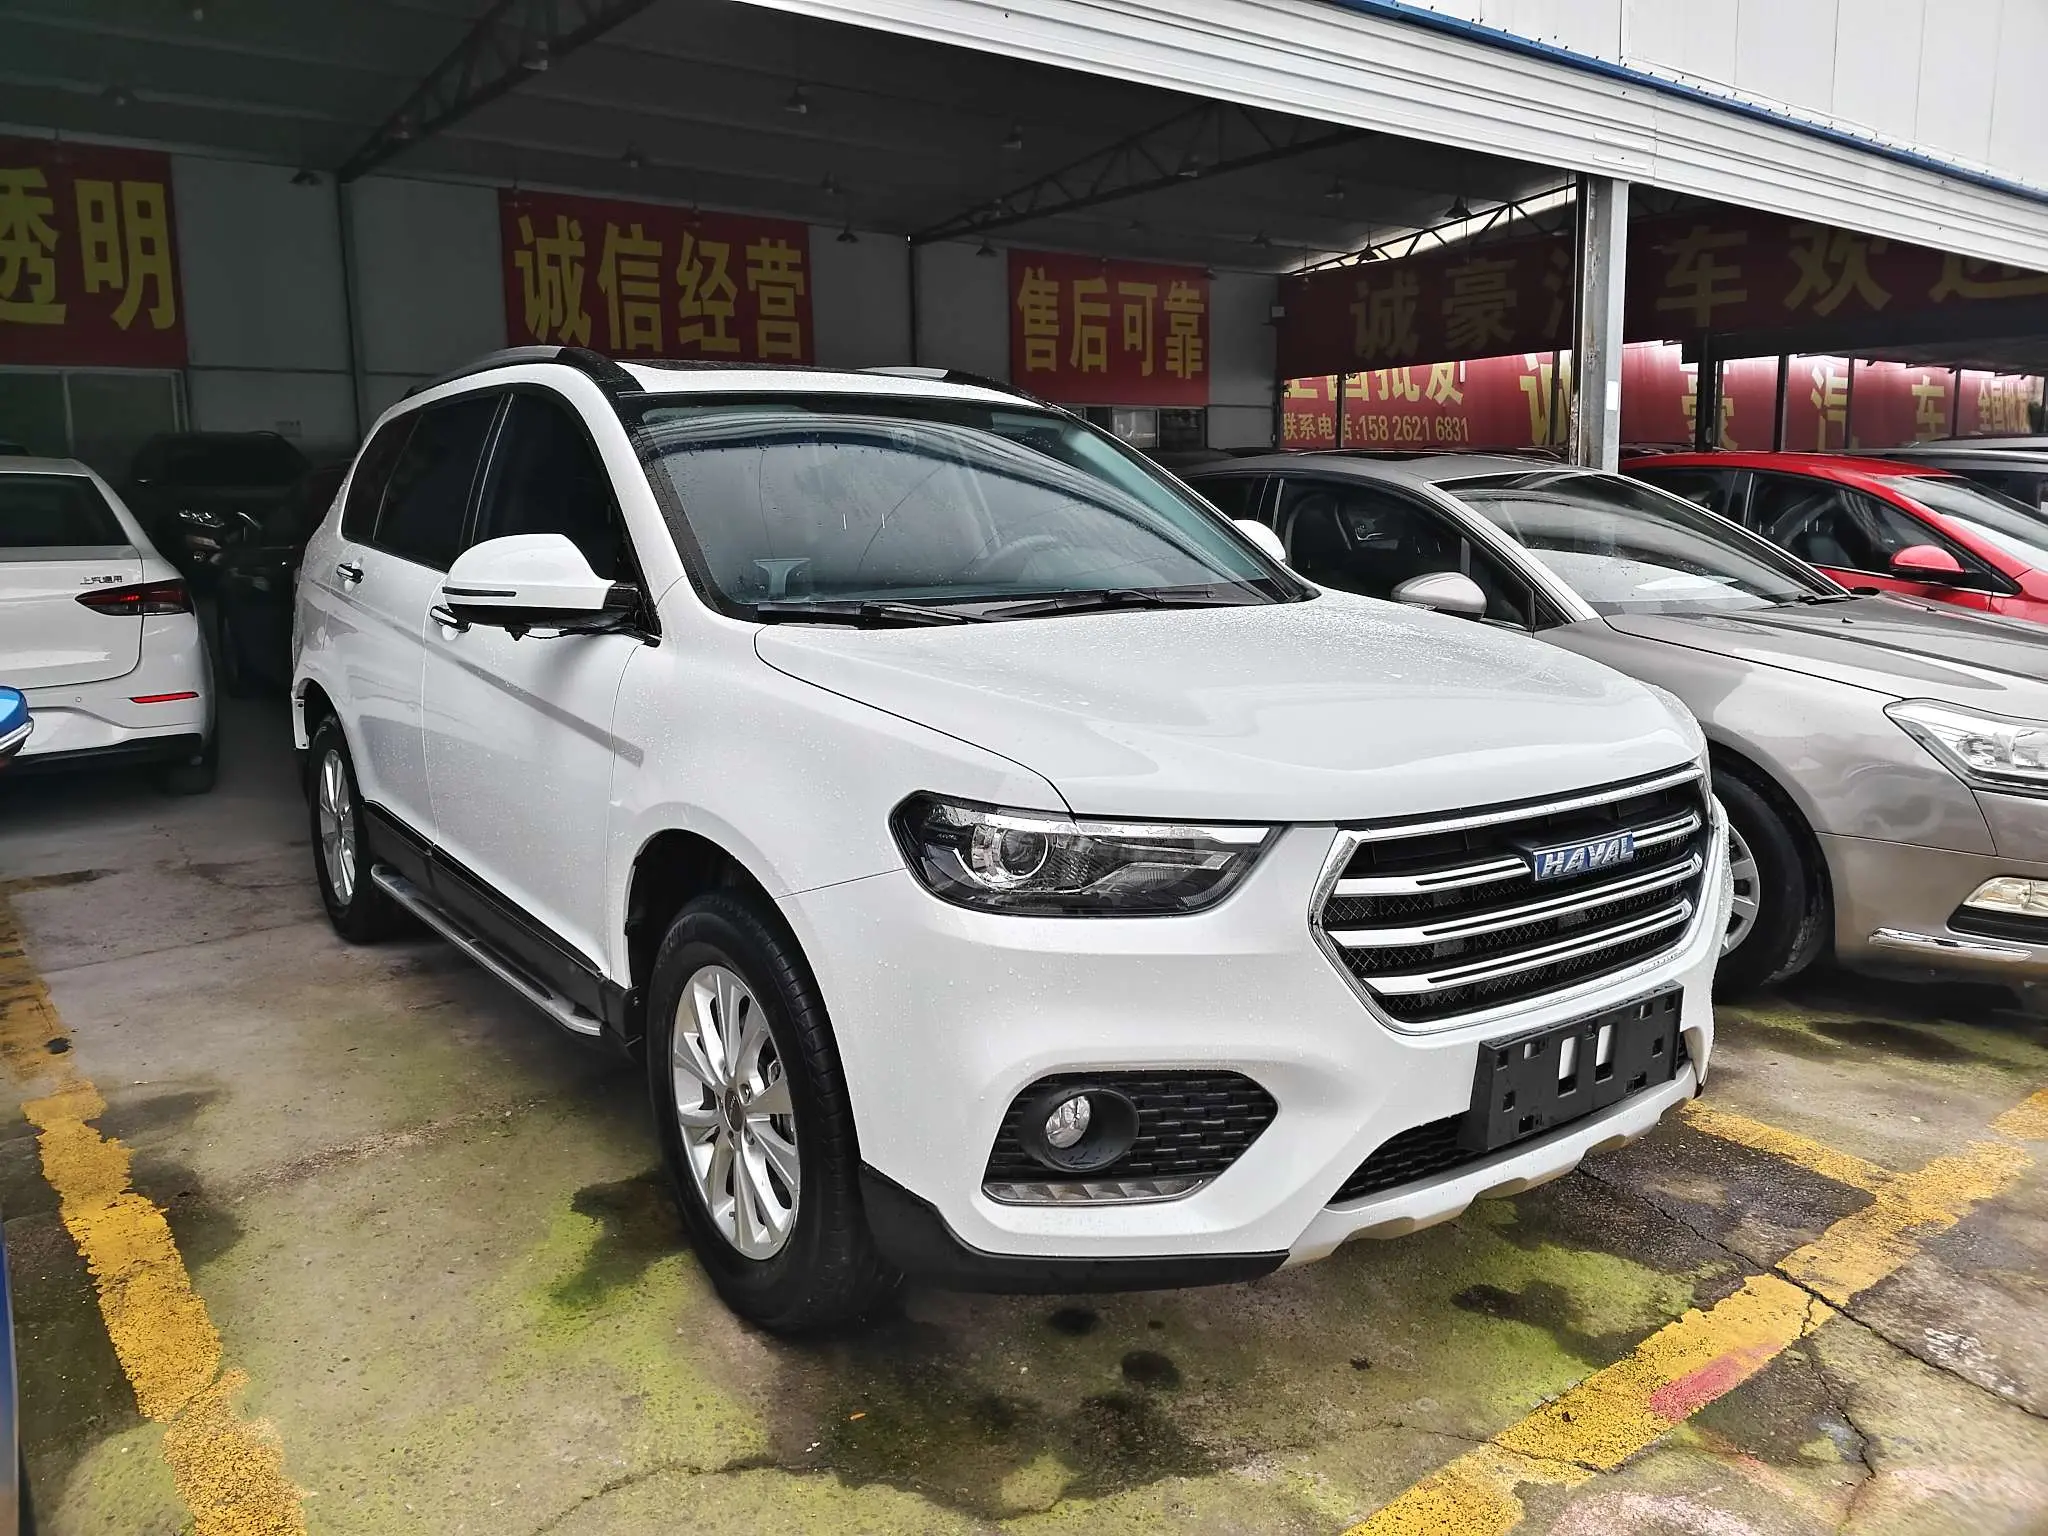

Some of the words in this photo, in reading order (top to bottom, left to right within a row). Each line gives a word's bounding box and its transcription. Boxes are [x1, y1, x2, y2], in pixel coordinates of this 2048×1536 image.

[514, 214, 805, 359] 诚信经营
[1017, 264, 1204, 379] 售后可靠
[1392, 416, 1430, 441] 2621
[1434, 415, 1470, 442] 6831
[1540, 837, 1634, 878] HAVAL
